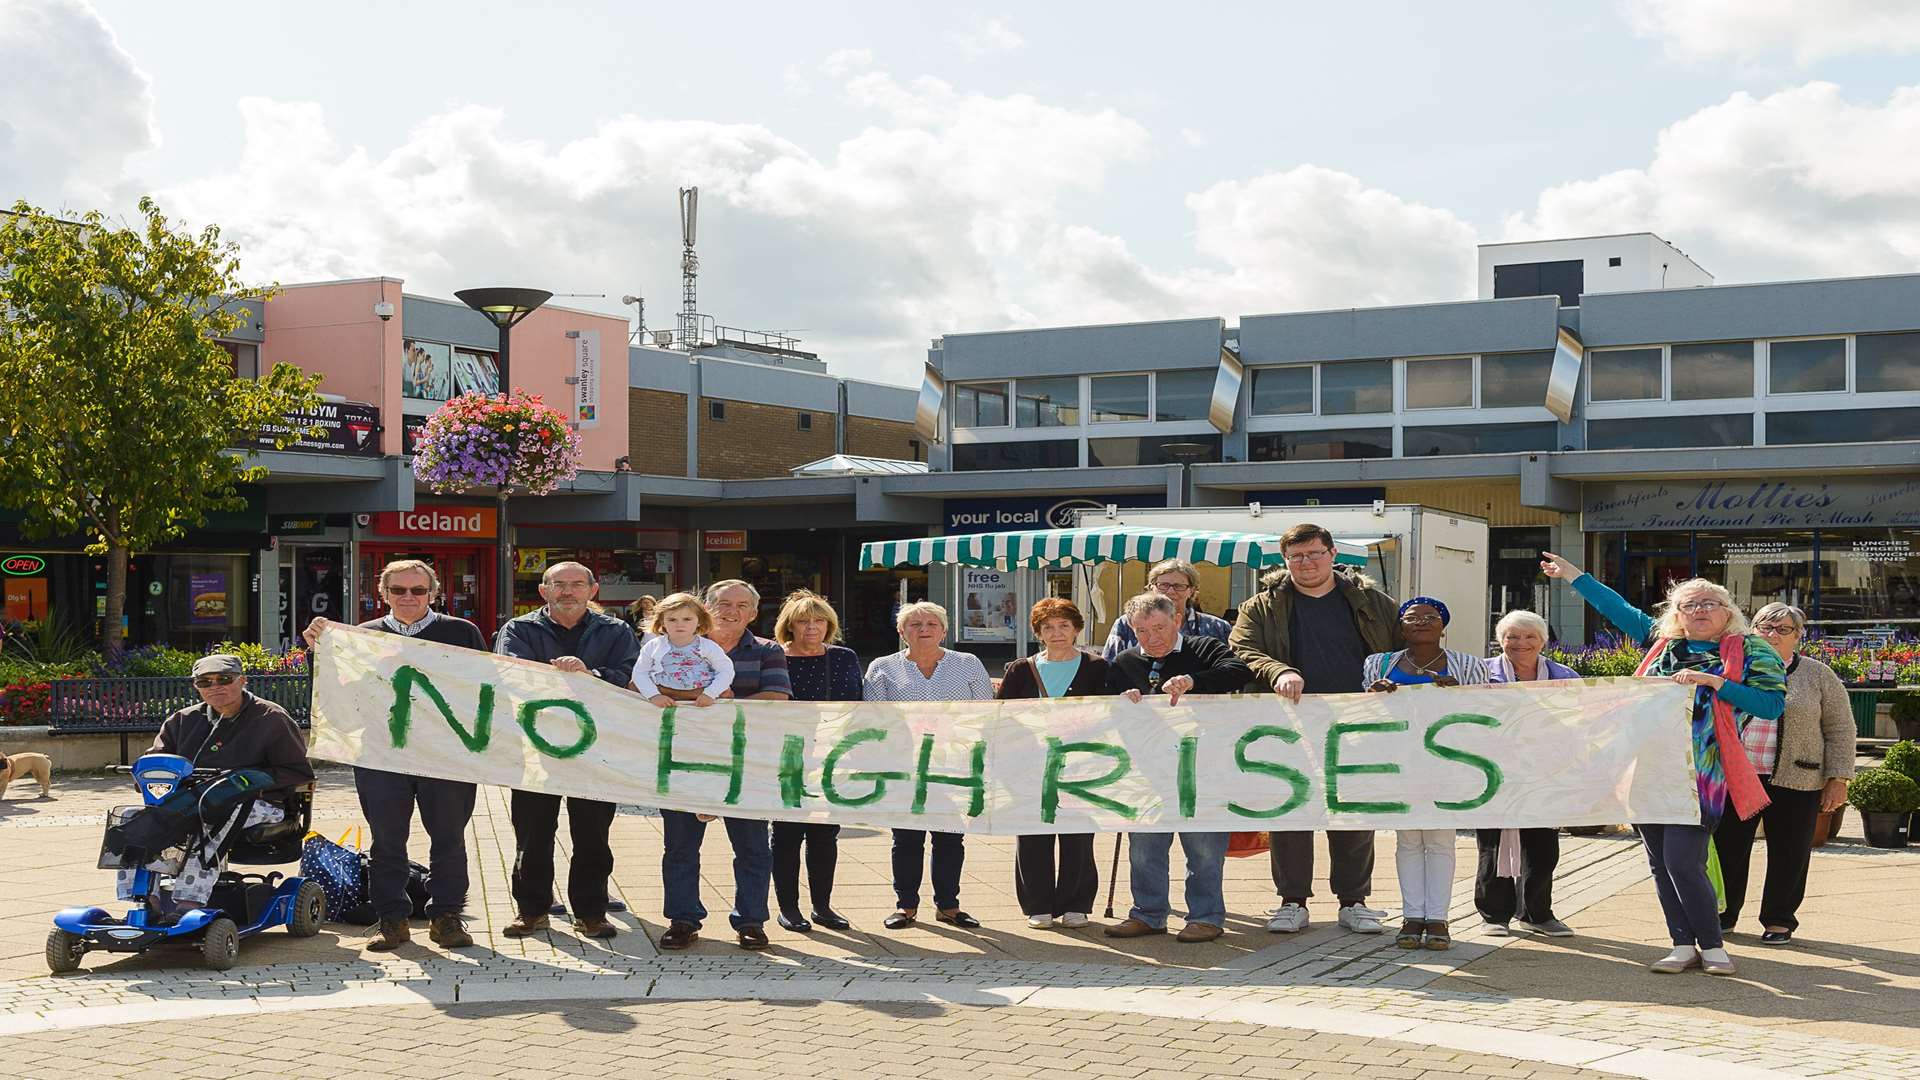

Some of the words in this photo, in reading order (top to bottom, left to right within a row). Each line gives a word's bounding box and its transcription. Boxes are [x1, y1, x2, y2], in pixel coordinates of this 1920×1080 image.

[581, 339, 589, 367] square
[580, 369, 589, 403] swanley
[314, 419, 341, 429] BOXING
[344, 414, 374, 423] TOTAL
[1675, 481, 1840, 511] Mollie's
[281, 520, 318, 529] SUBWAY
[399, 511, 481, 532] Iceland
[951, 513, 990, 527] your
[996, 509, 1039, 524] local
[1642, 513, 1755, 528] Traditional
[1821, 511, 1875, 524] Mash
[706, 535, 742, 545] Iceland
[6, 559, 40, 571] OPEN
[967, 571, 1000, 583] free
[655, 701, 987, 818] HIGH
[1040, 712, 1505, 824] RISES
